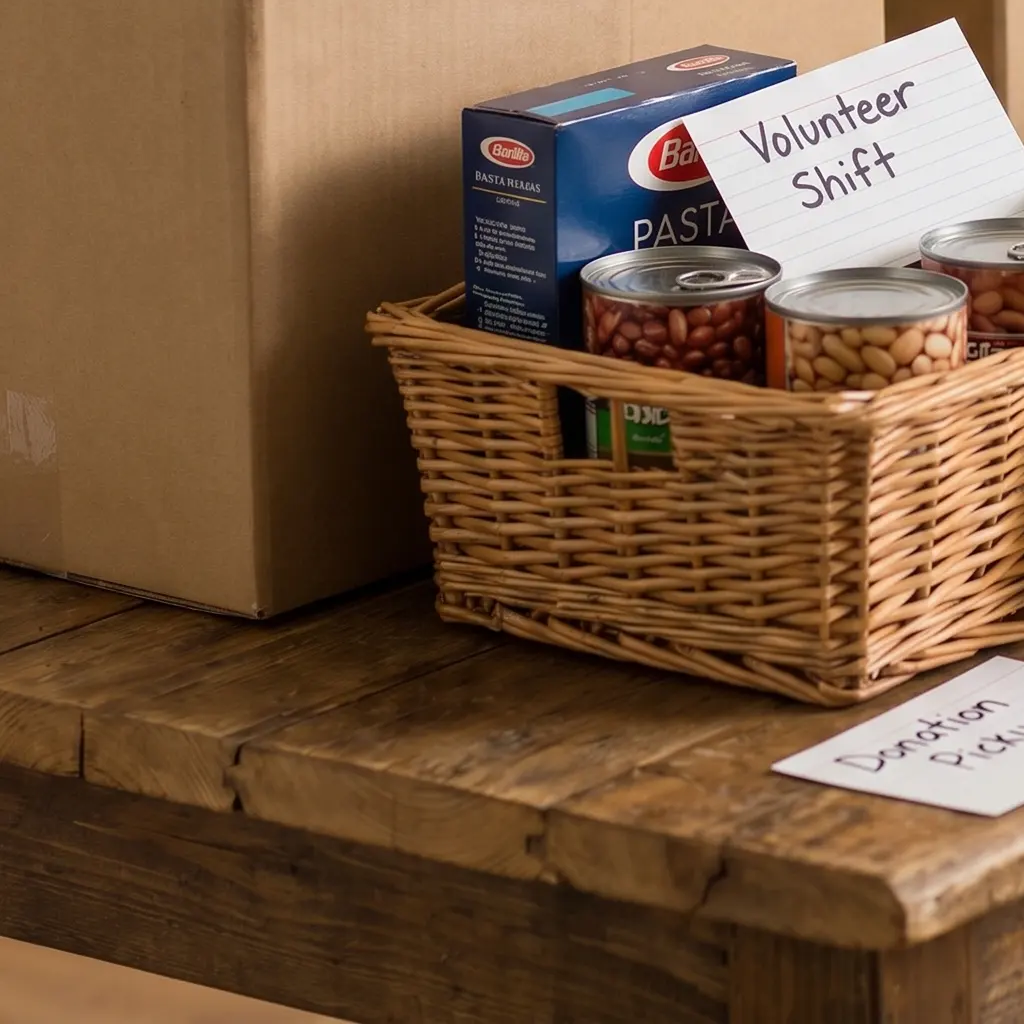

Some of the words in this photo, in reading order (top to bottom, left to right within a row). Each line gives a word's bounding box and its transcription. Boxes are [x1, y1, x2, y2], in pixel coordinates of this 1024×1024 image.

[739, 80, 915, 164] Volunteer
[792, 141, 896, 209] Shift
[834, 698, 1010, 774] Donation
